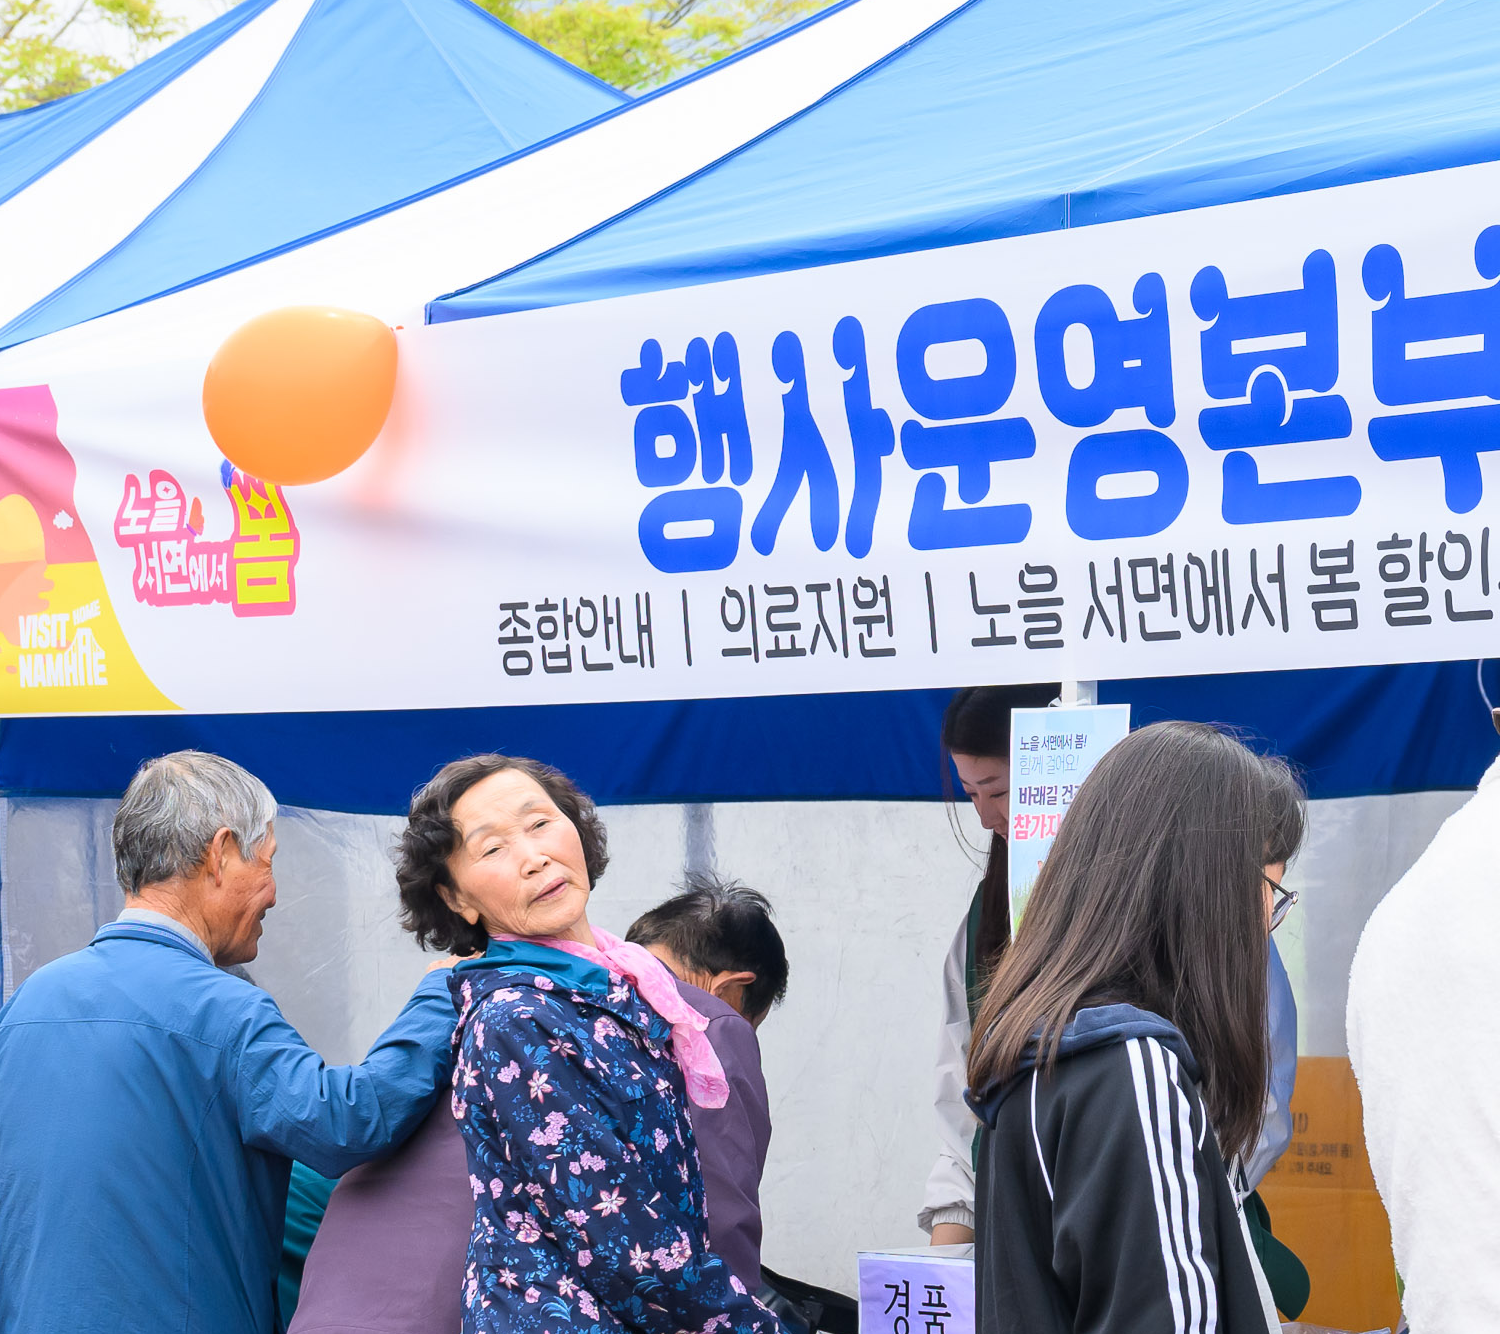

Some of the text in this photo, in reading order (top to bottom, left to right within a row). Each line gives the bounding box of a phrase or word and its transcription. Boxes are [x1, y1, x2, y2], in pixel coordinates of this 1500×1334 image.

[119, 480, 181, 536] 노을
[138, 482, 294, 604] 서면에서 봄
[497, 588, 657, 677] 종합안내
[720, 575, 896, 662] 의료지원
[970, 563, 1064, 653] 노을
[1083, 544, 1289, 645] 서면에서
[1305, 539, 1361, 634] 봄
[18, 614, 70, 649] VISIT
[18, 628, 107, 687] NAMHAE
[1020, 733, 1088, 751] 노을 서면에서 봄!
[1020, 755, 1043, 776] 함께
[1018, 785, 1058, 806] 바래길
